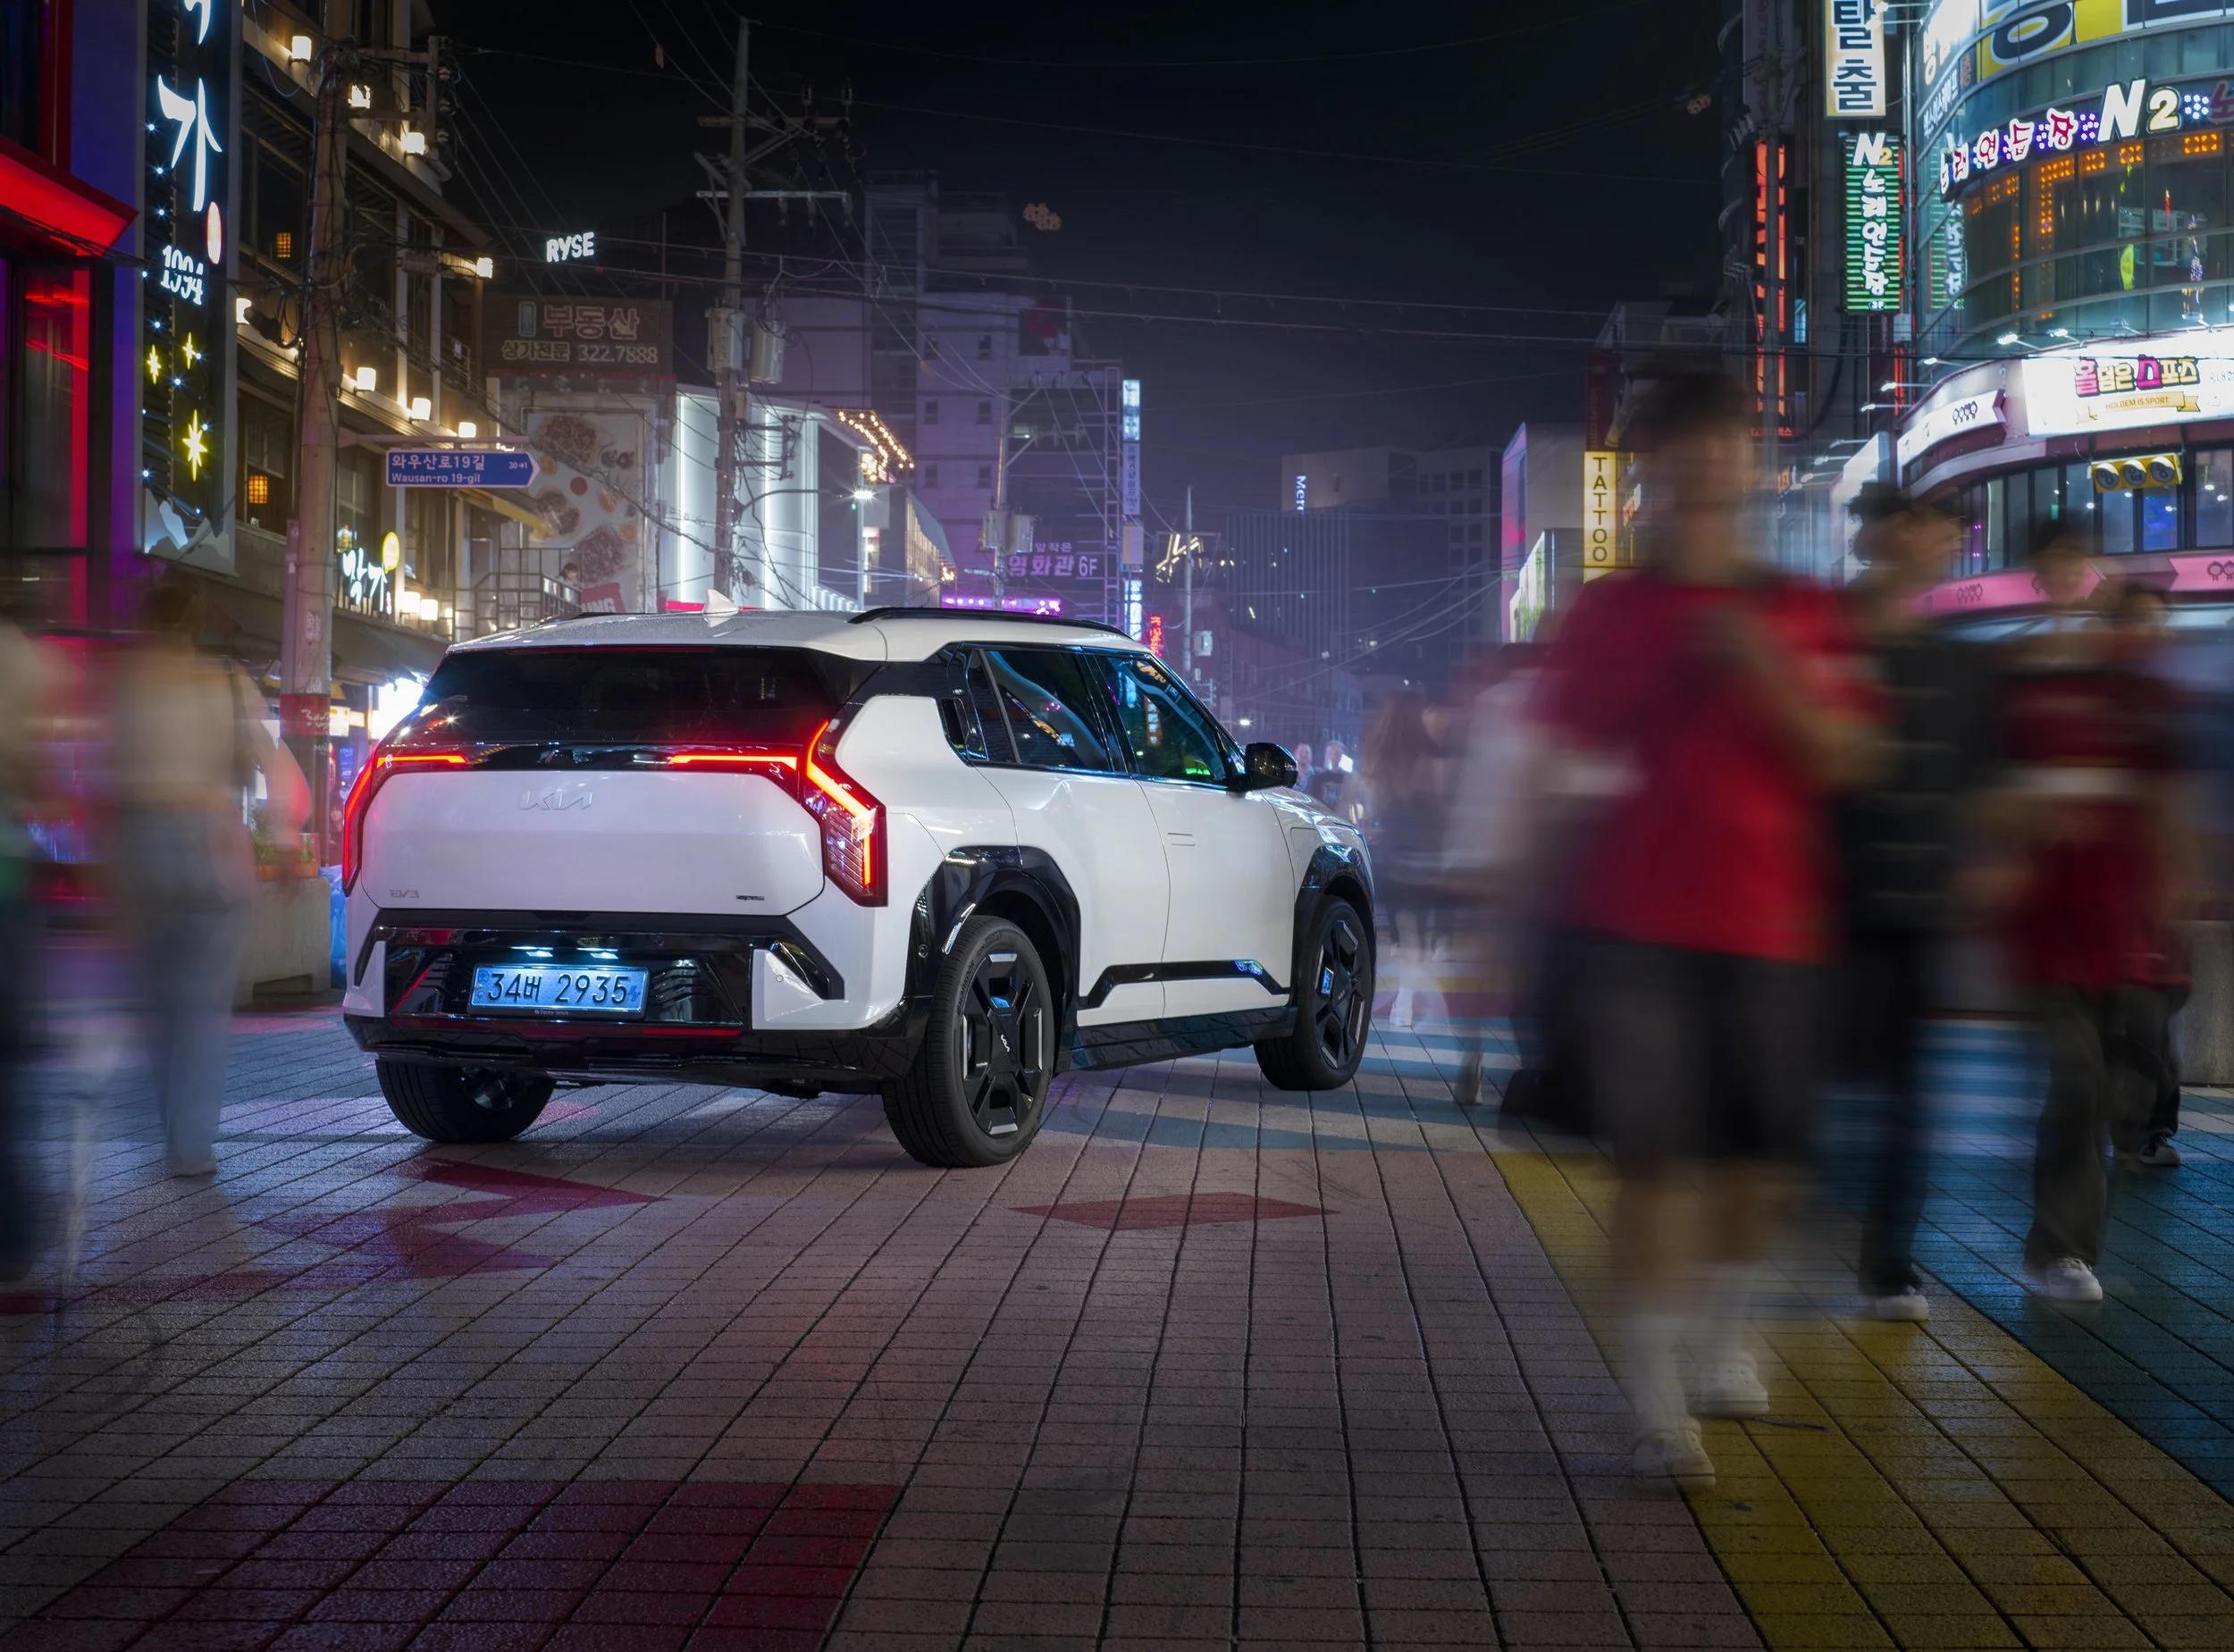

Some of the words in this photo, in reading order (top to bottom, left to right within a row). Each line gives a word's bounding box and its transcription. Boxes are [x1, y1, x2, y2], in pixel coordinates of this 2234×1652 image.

[2098, 79, 2180, 141] N2
[1852, 133, 1893, 165] N2
[546, 231, 595, 263] RYSE
[542, 305, 640, 340] 부동산
[2146, 396, 2170, 406] SPORT
[391, 455, 485, 471] 와우산로19길
[391, 473, 449, 483] Wausan-ro
[451, 473, 481, 485] 19-gil
[1592, 457, 1608, 562] TATTOO
[1008, 555, 1076, 577] 영화관
[1079, 555, 1098, 577] 6F
[519, 789, 593, 811] KIA
[487, 973, 542, 1002] 34버
[555, 973, 629, 1004] 2935
